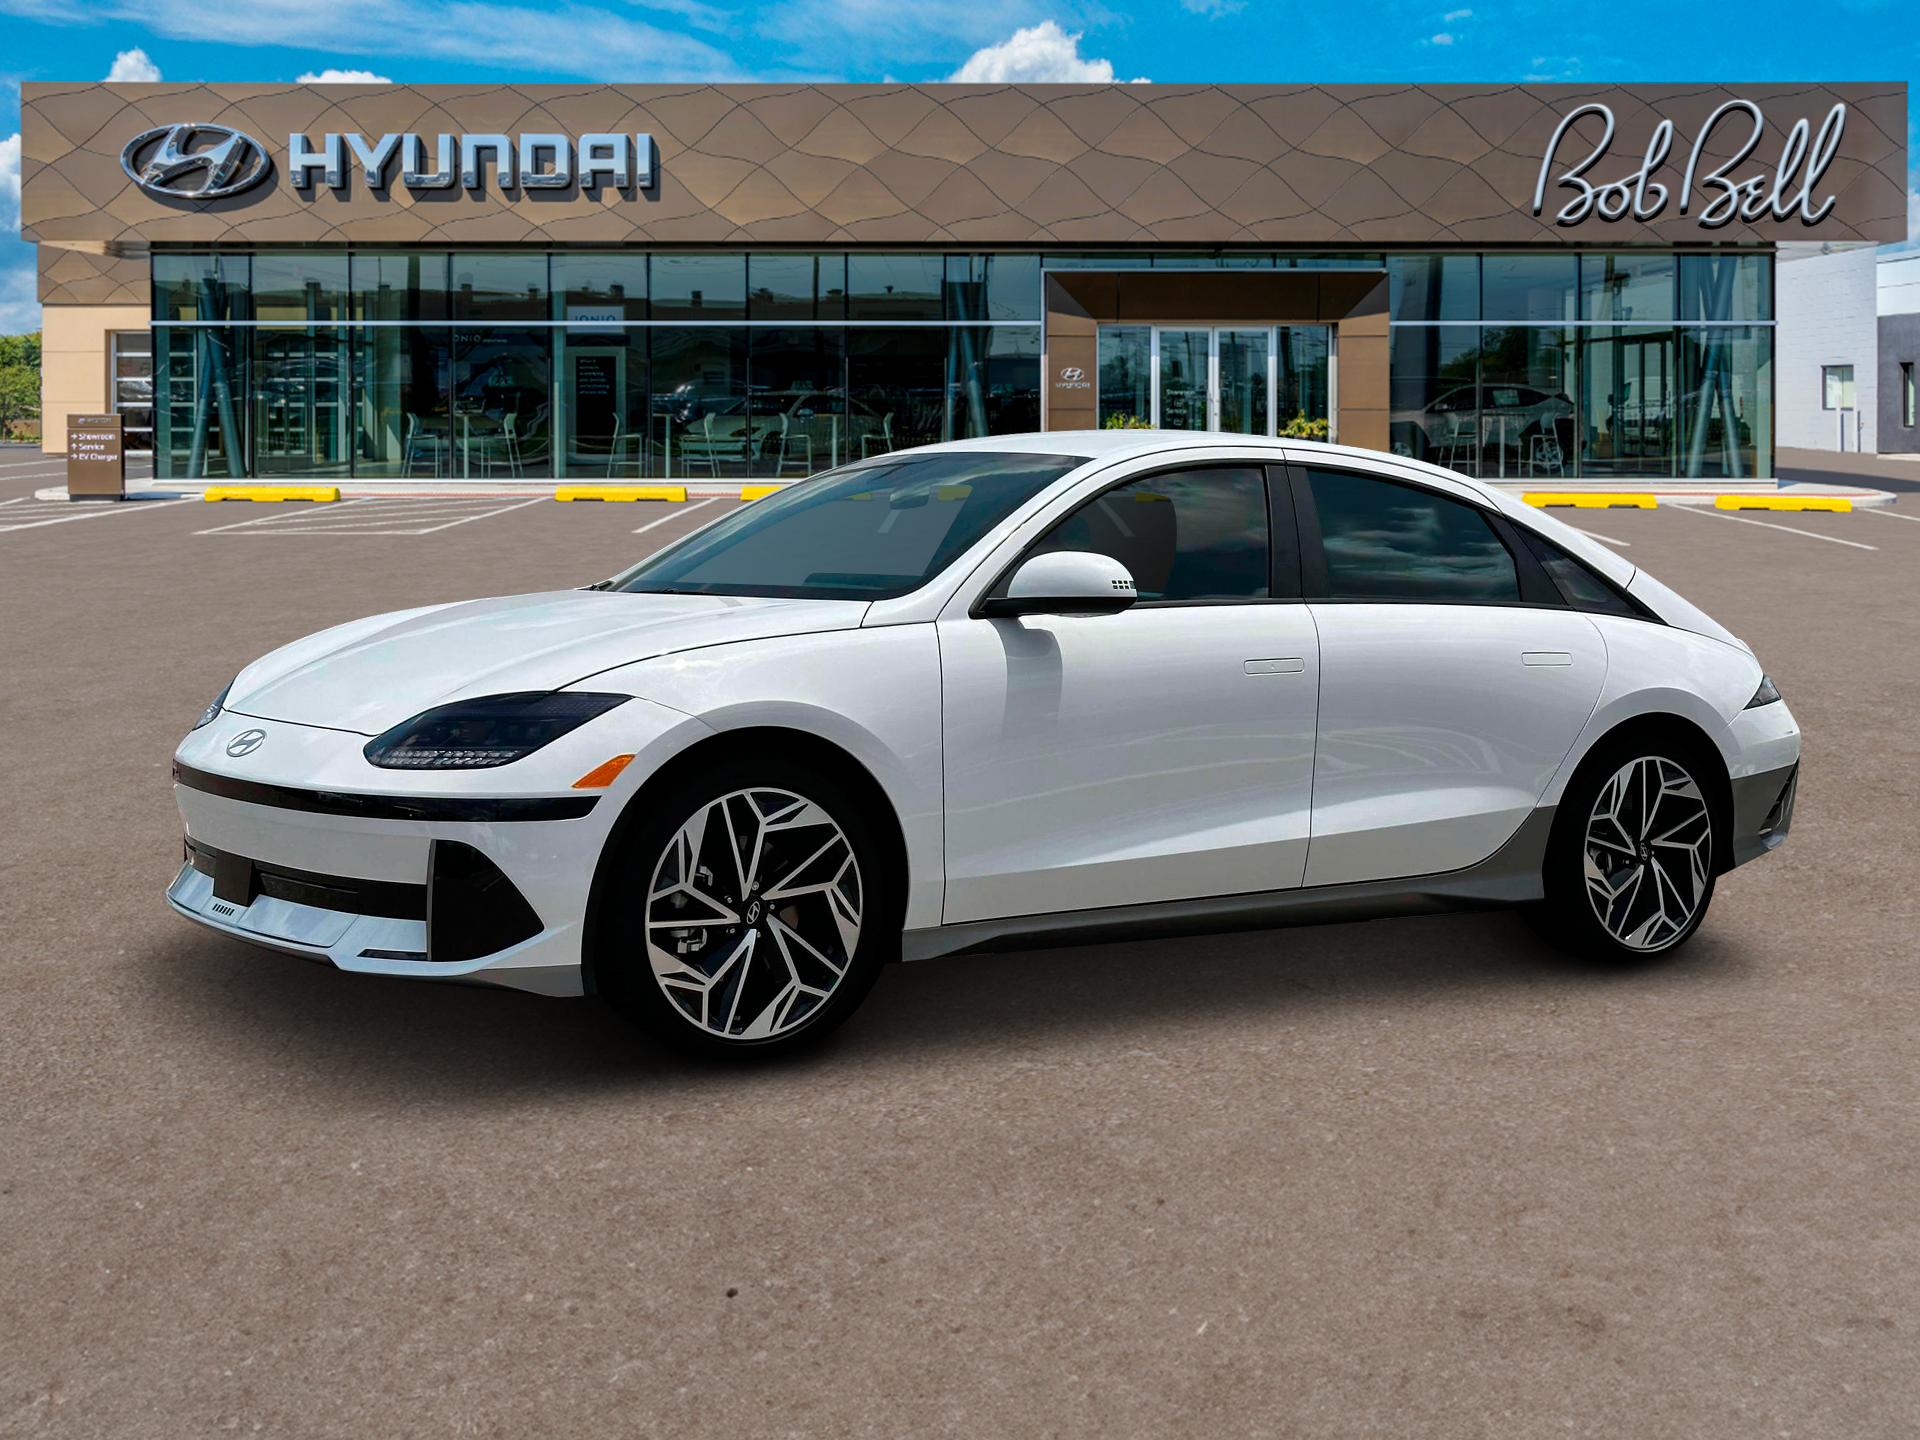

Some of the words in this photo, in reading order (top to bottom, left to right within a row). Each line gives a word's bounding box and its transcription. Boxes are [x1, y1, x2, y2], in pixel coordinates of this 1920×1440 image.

[289, 133, 655, 189] HYUNDAI
[1534, 103, 1673, 221] Bob
[1680, 100, 1846, 224] Bell
[78, 442, 105, 450] Service
[90, 453, 118, 462] Charger
